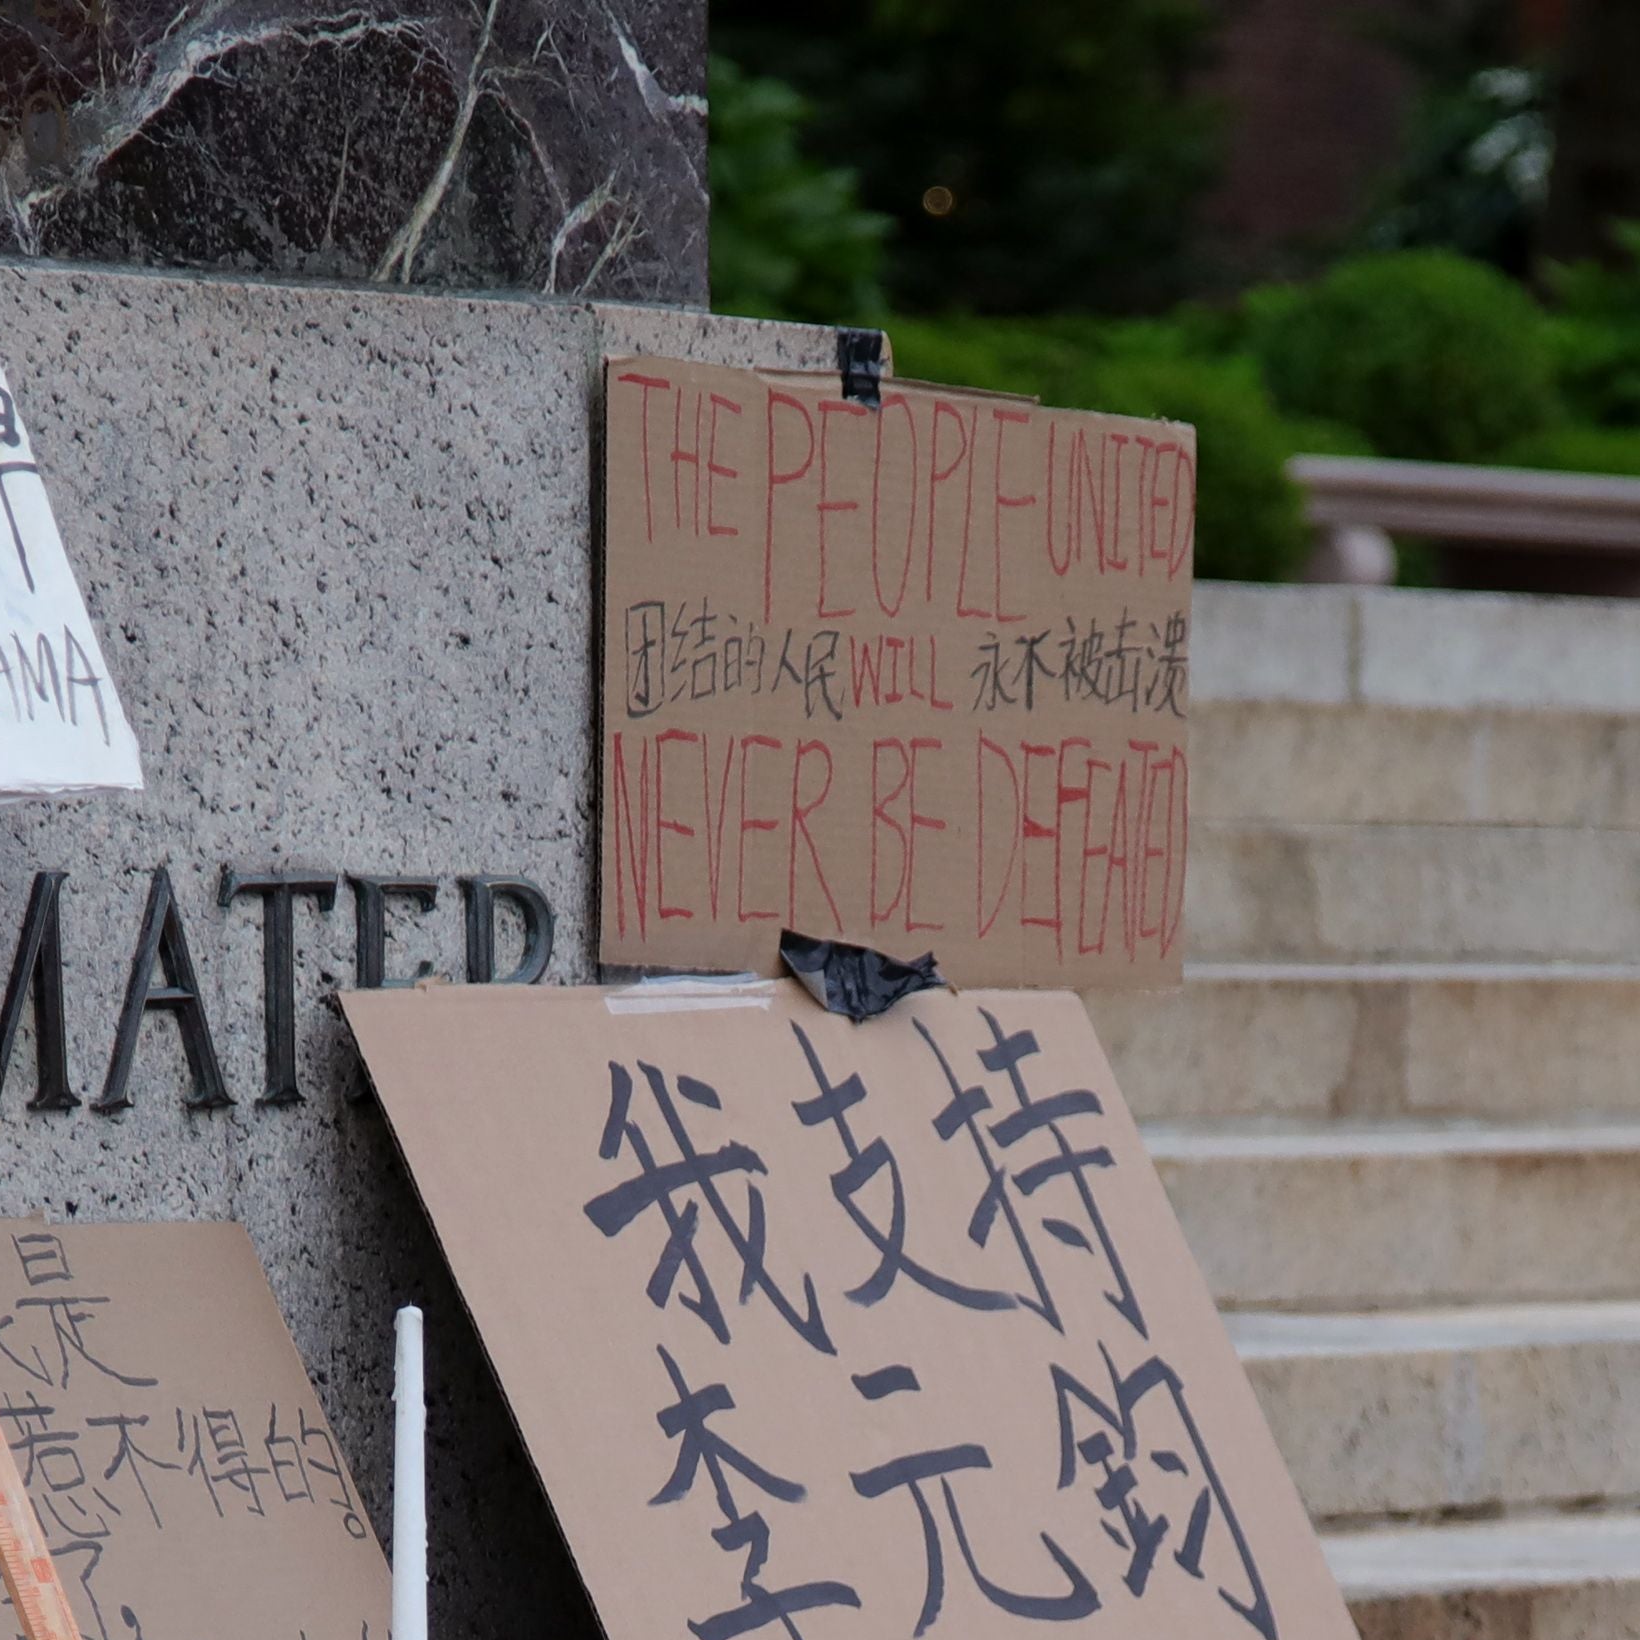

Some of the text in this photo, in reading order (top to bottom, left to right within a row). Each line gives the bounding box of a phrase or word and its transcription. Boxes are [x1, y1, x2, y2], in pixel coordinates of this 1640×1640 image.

[617, 373, 1196, 624] THE PEOPLE UNITED
[848, 633, 954, 710] WILL
[613, 728, 1188, 964] NEVER BE DEFEATED
[583, 1007, 1149, 1356] 我支持
